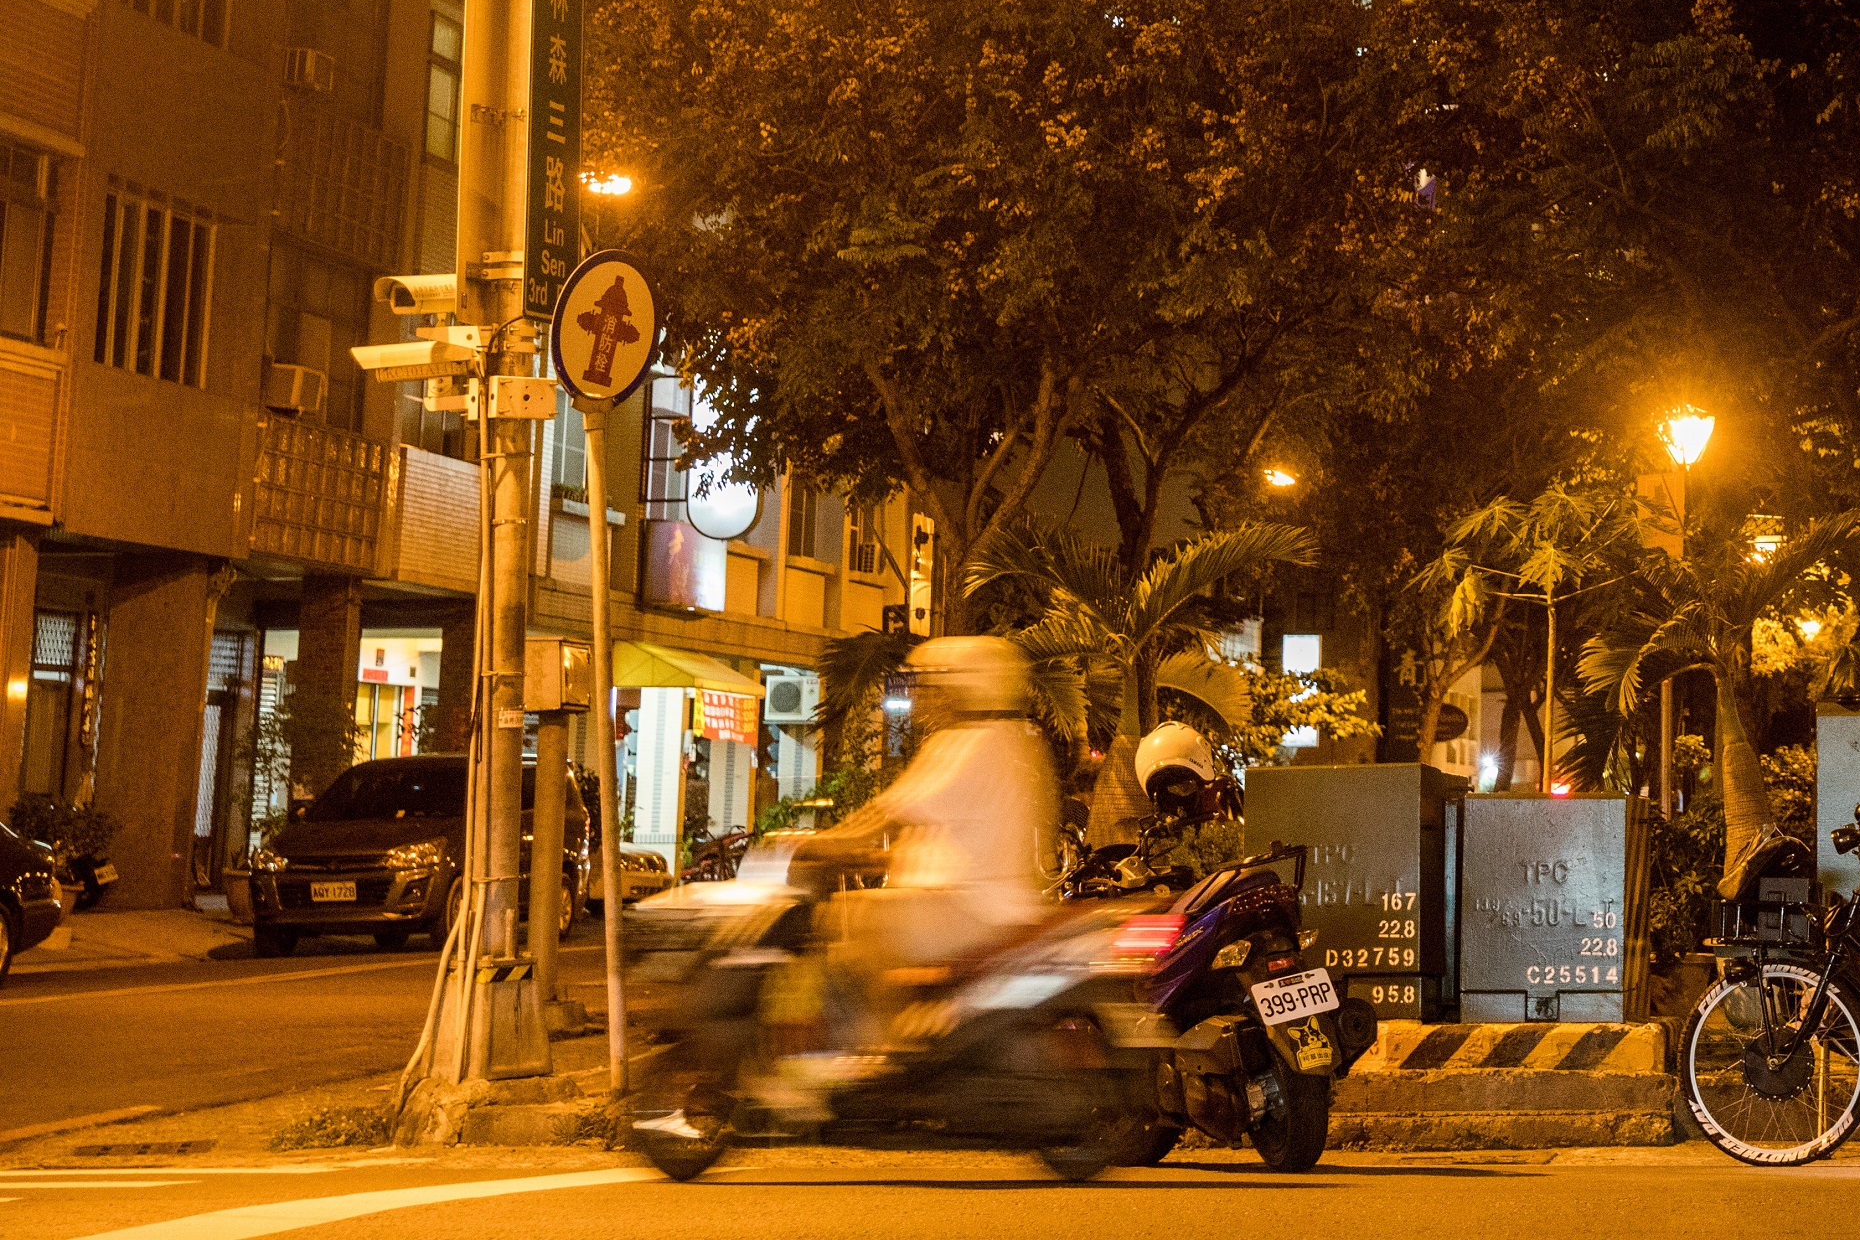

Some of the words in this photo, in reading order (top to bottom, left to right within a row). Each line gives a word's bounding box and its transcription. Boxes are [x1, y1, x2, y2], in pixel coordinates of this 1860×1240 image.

[544, 218, 565, 247] Lin
[541, 249, 566, 279] Sen
[528, 276, 548, 306] 3rd
[595, 314, 617, 372] 消防栓
[1520, 860, 1568, 884] TPC
[1382, 892, 1417, 911] 167
[1378, 919, 1416, 938] 22.8
[1593, 910, 1617, 929] 50
[1581, 937, 1618, 956] 22.8
[1325, 947, 1415, 967] D32759
[1527, 965, 1618, 985] C25514
[1372, 984, 1415, 1004] 95.8
